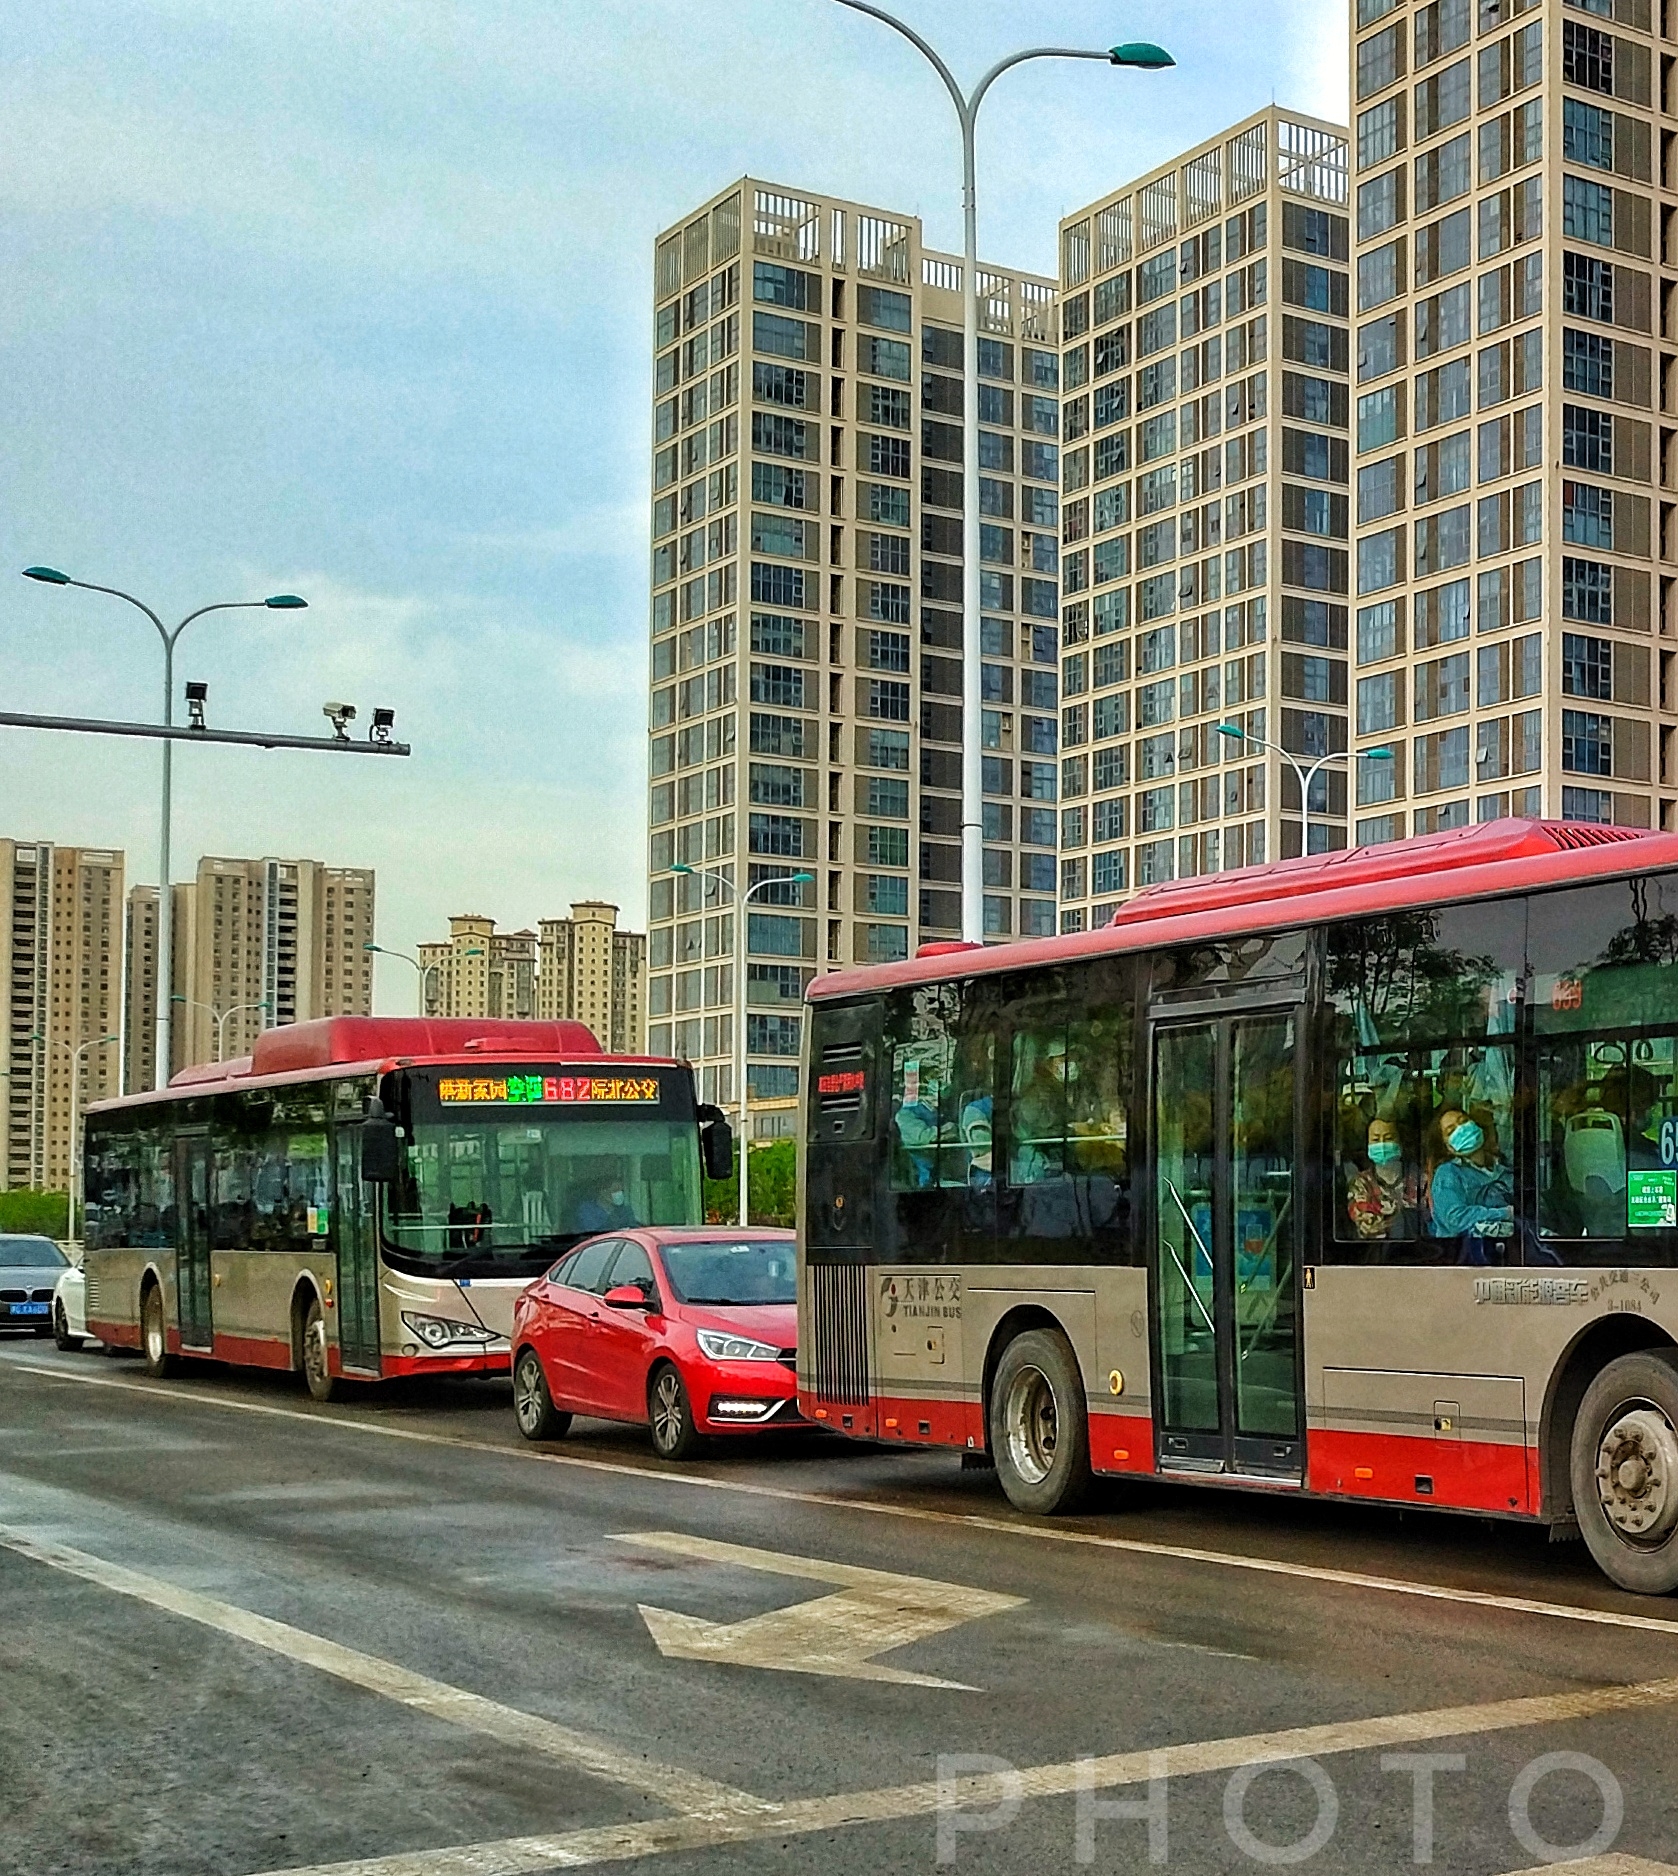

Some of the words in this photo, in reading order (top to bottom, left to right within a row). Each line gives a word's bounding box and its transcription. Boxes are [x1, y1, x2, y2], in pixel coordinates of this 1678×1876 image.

[544, 1076, 590, 1101] 682
[903, 1277, 961, 1301] 天津公交
[903, 1305, 940, 1318] TIANJIN
[942, 1306, 962, 1319] BUS
